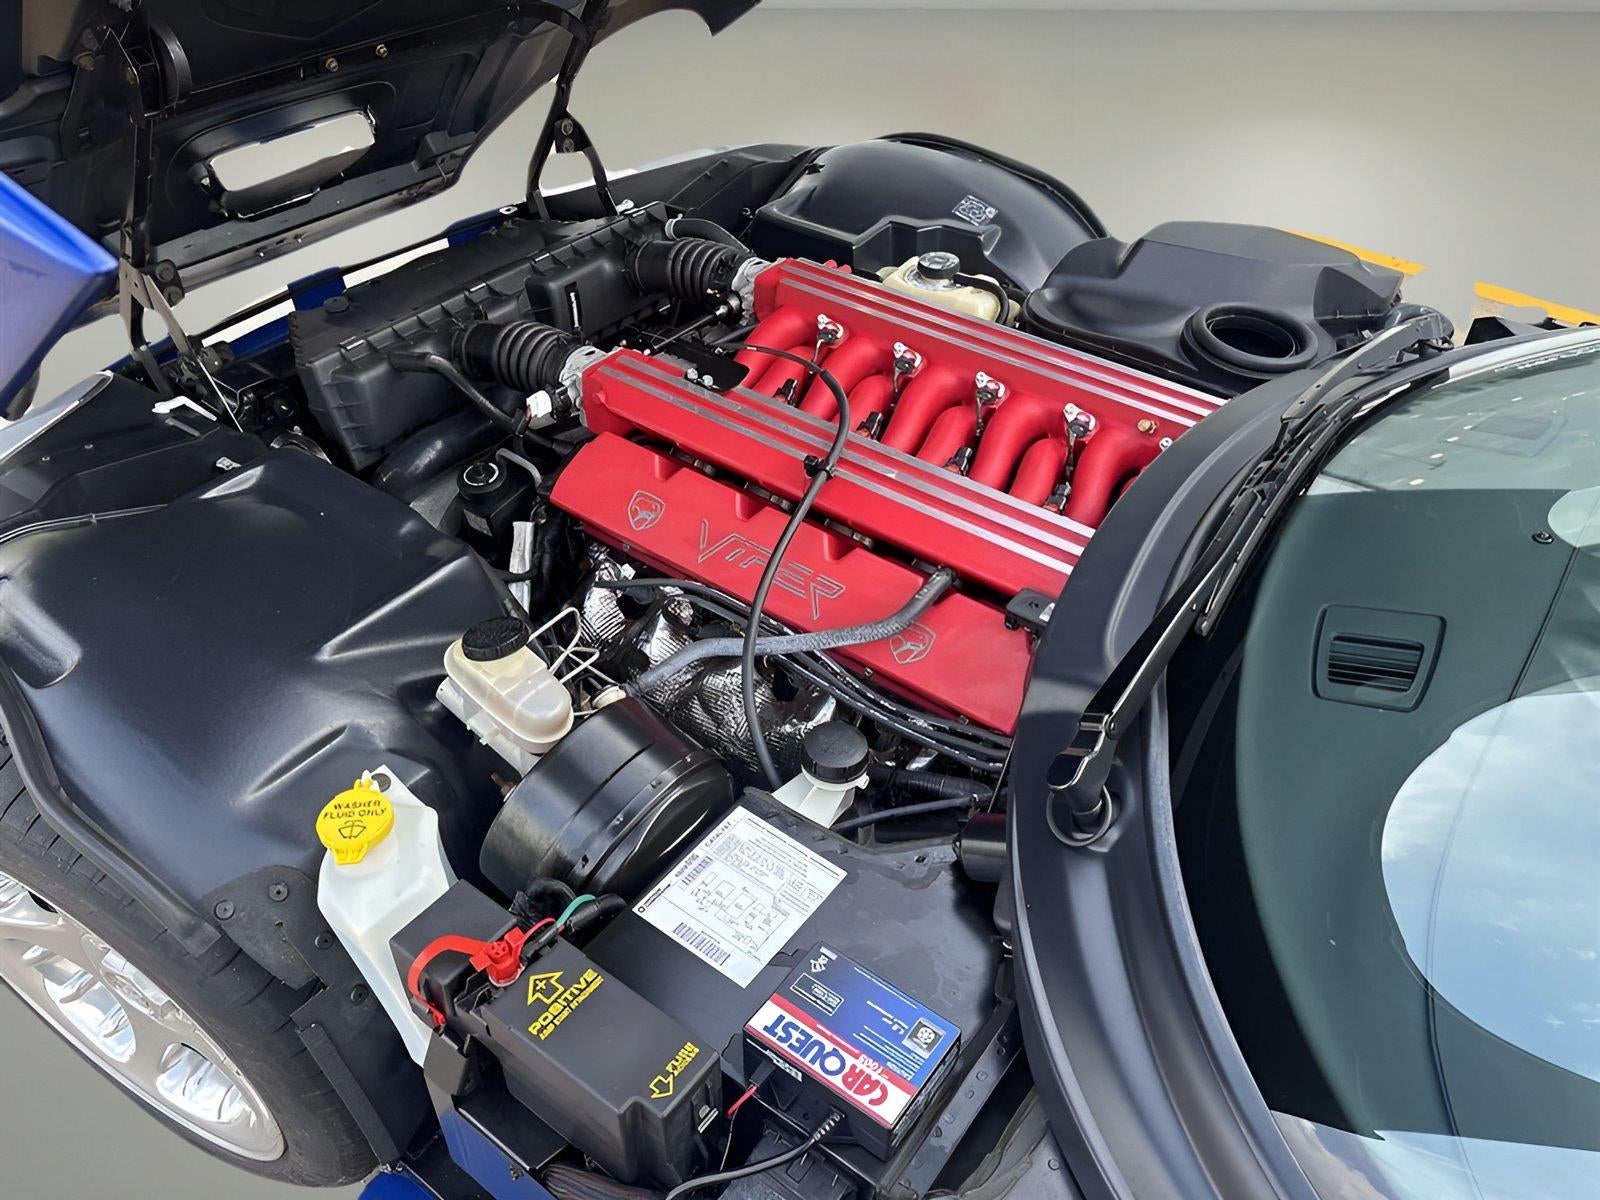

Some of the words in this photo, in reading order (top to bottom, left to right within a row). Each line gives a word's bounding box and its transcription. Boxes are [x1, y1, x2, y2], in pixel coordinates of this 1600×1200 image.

[698, 518, 846, 621] VIPER
[323, 810, 355, 820] FLUID
[358, 807, 388, 818] ONLY
[333, 800, 381, 811] WASHER
[528, 968, 598, 1036] POSITIVE
